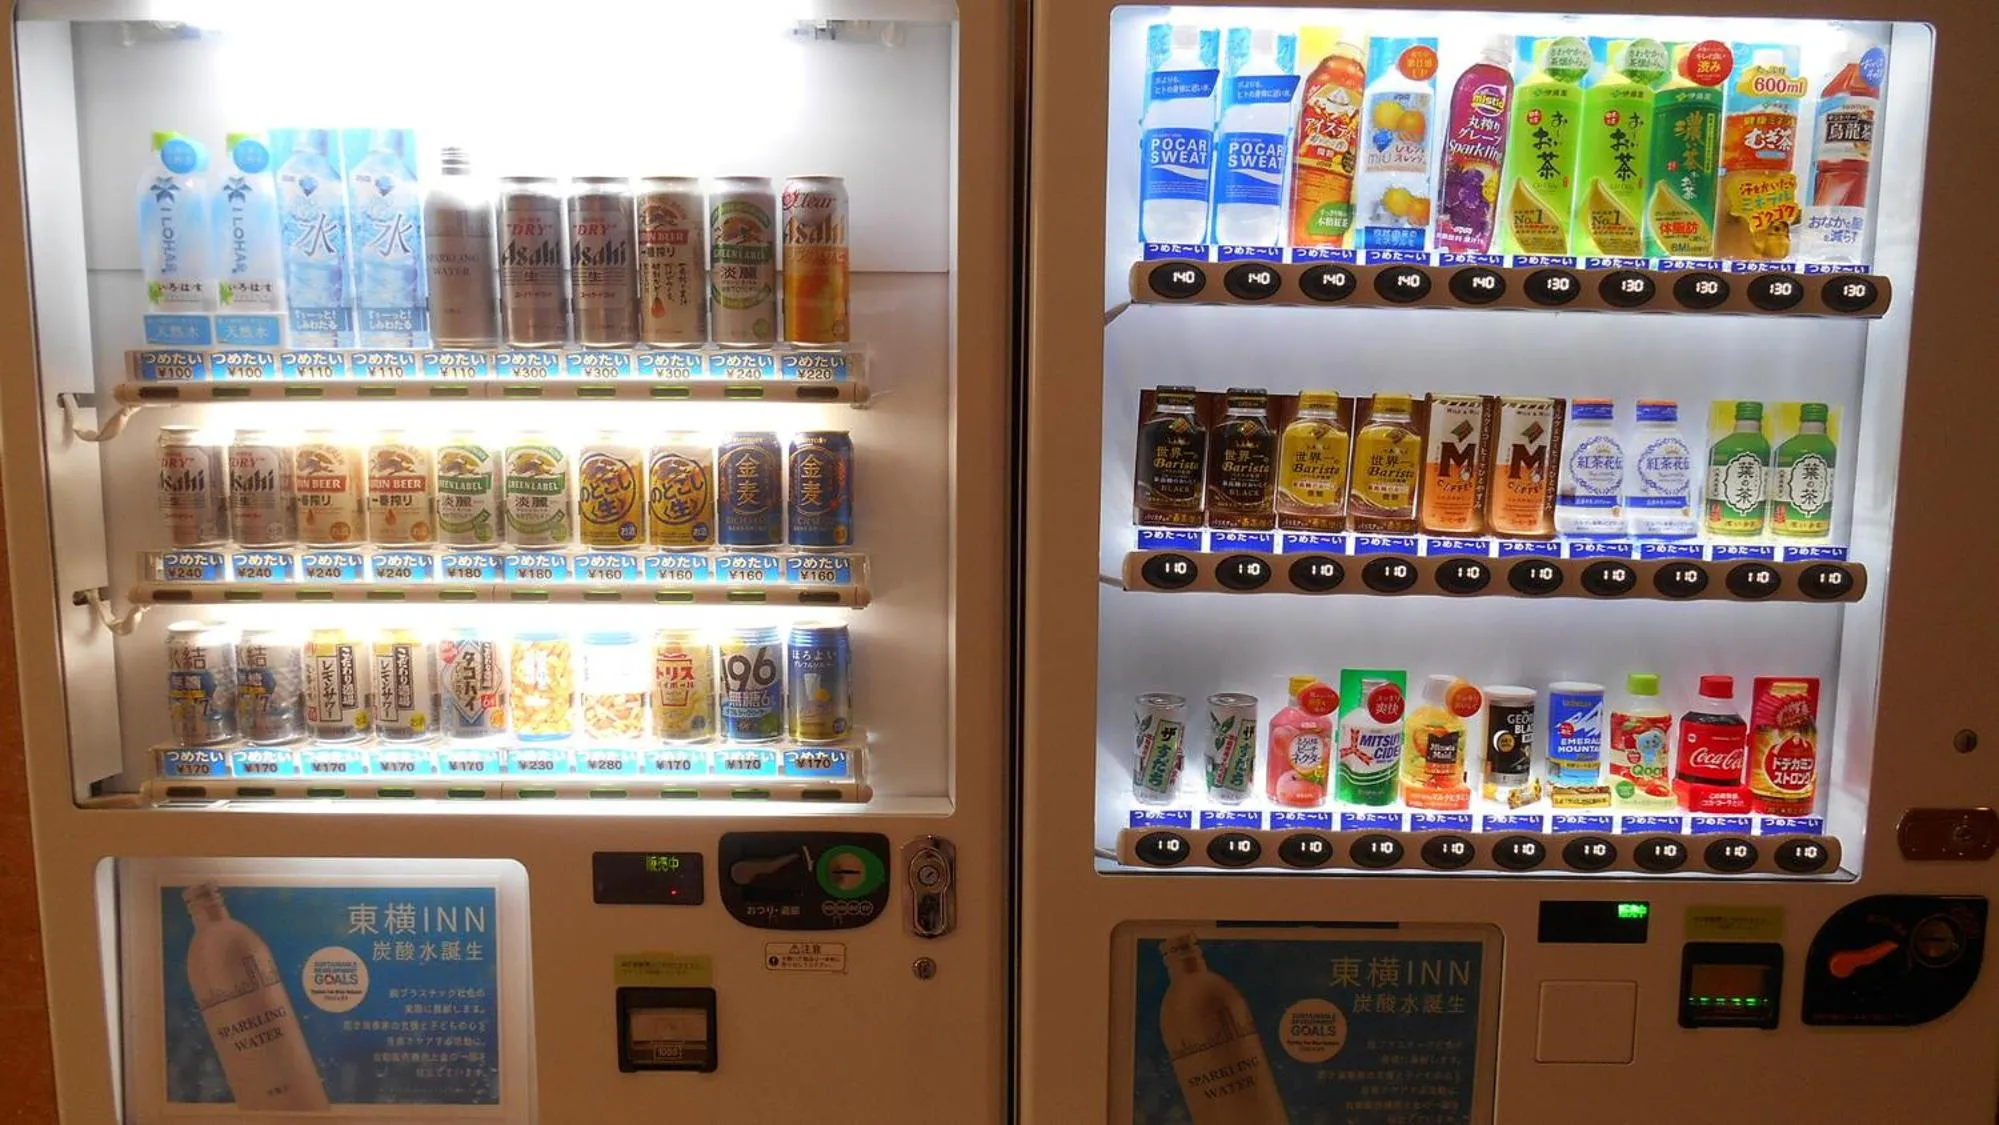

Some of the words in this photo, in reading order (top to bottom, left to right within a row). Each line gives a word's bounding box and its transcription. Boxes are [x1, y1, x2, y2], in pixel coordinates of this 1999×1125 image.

[1754, 76, 1805, 94] 600ml
[1151, 137, 1208, 151] POCAR
[1744, 125, 1794, 151] むぎ茶
[1150, 149, 1207, 165] SWEAT
[1227, 154, 1284, 171] SWEAT
[1513, 209, 1544, 225] No.1
[1590, 210, 1622, 227] No.1
[1751, 205, 1796, 227] ゴクゴク
[293, 212, 338, 257] 水
[368, 212, 414, 257] 水
[784, 213, 846, 245] Asahi
[502, 239, 563, 267] Asahi
[571, 239, 626, 267] Asahi
[1173, 270, 1195, 284] 140
[1248, 271, 1271, 285] 140
[1323, 273, 1346, 286] 140
[1397, 274, 1420, 288] 140
[1472, 276, 1495, 289] 140
[1547, 277, 1570, 291] 130
[1621, 279, 1644, 292] 130
[1696, 281, 1718, 294] 130
[1769, 282, 1792, 296] 130
[1843, 284, 1866, 297] 130
[142, 353, 207, 366] つめたい
[211, 353, 275, 366] つめたい
[423, 353, 488, 366] つめたい
[639, 353, 702, 366] つめたい
[783, 354, 846, 367] つめたい
[157, 366, 192, 379] ¥100
[227, 366, 262, 379] ¥100
[297, 366, 333, 379] ¥110
[368, 366, 404, 379] ¥110
[440, 366, 476, 379] ¥110
[512, 366, 548, 379] ¥300
[585, 366, 620, 379] ¥300
[656, 366, 691, 379] ¥300
[726, 366, 762, 379] ¥240
[796, 366, 832, 379] ¥220
[1438, 441, 1477, 478] M
[1508, 443, 1548, 480] M
[312, 479, 341, 489] BEER
[393, 479, 422, 489] BEER
[735, 453, 761, 507] 金麦
[799, 453, 825, 507] 金麦
[1735, 461, 1754, 504] 葉の茶
[1800, 463, 1818, 505] 葉の茶
[163, 553, 224, 567] つめたい
[372, 553, 433, 567] つめたい
[574, 554, 636, 567] つめたい
[788, 554, 850, 567] つめたい
[167, 567, 203, 580] ¥240
[237, 567, 272, 580] ¥240
[306, 567, 341, 580] ¥240
[376, 567, 411, 580] ¥240
[447, 567, 482, 580] ¥180
[587, 568, 623, 580] ¥160
[657, 568, 693, 580] ¥160
[729, 568, 764, 580] ¥160
[800, 568, 836, 580] ¥160
[1165, 561, 1187, 574] 110
[1238, 563, 1260, 576] 110
[1312, 564, 1334, 577] 110
[1385, 565, 1407, 578] 110
[1458, 566, 1480, 579] 110
[1531, 567, 1553, 580] 110
[1603, 569, 1625, 582] 110
[1676, 570, 1698, 583] 110
[1748, 571, 1770, 584] 110
[1820, 572, 1842, 584] 110
[656, 666, 695, 681] トリス
[462, 651, 478, 712] タコハイ
[176, 761, 211, 774] ¥170
[244, 761, 278, 774] ¥170
[312, 761, 347, 774] ¥170
[380, 761, 415, 774] ¥170
[448, 761, 485, 774] ¥170
[518, 759, 555, 771] ¥230
[587, 759, 623, 771] ¥280
[656, 759, 691, 771] ¥170
[725, 759, 762, 771] ¥170
[796, 759, 831, 771] ¥170
[1772, 756, 1814, 771] ドデカミン
[1773, 773, 1812, 786] ストロング
[1158, 839, 1180, 851] 110
[1229, 840, 1251, 852] 110
[1301, 841, 1322, 853] 110
[1372, 841, 1393, 854] 110
[1443, 842, 1464, 855] 110
[1513, 843, 1535, 855] 110
[1584, 844, 1606, 856] 110
[1655, 844, 1677, 857] 110
[1725, 845, 1747, 857] 110
[1796, 846, 1818, 858] 110
[348, 902, 488, 937] 東横INN
[371, 940, 484, 962] 炭酸水誕生
[314, 973, 359, 985] GOALS
[1329, 957, 1472, 989] 東横INN
[1351, 993, 1466, 1015] 炭酸水誕生
[216, 1005, 288, 1041] SPARKLING
[1290, 1024, 1336, 1037] GOALS
[232, 1026, 285, 1053] WATER
[1186, 1053, 1261, 1089] SPARKLING
[1203, 1075, 1256, 1100] WATER
